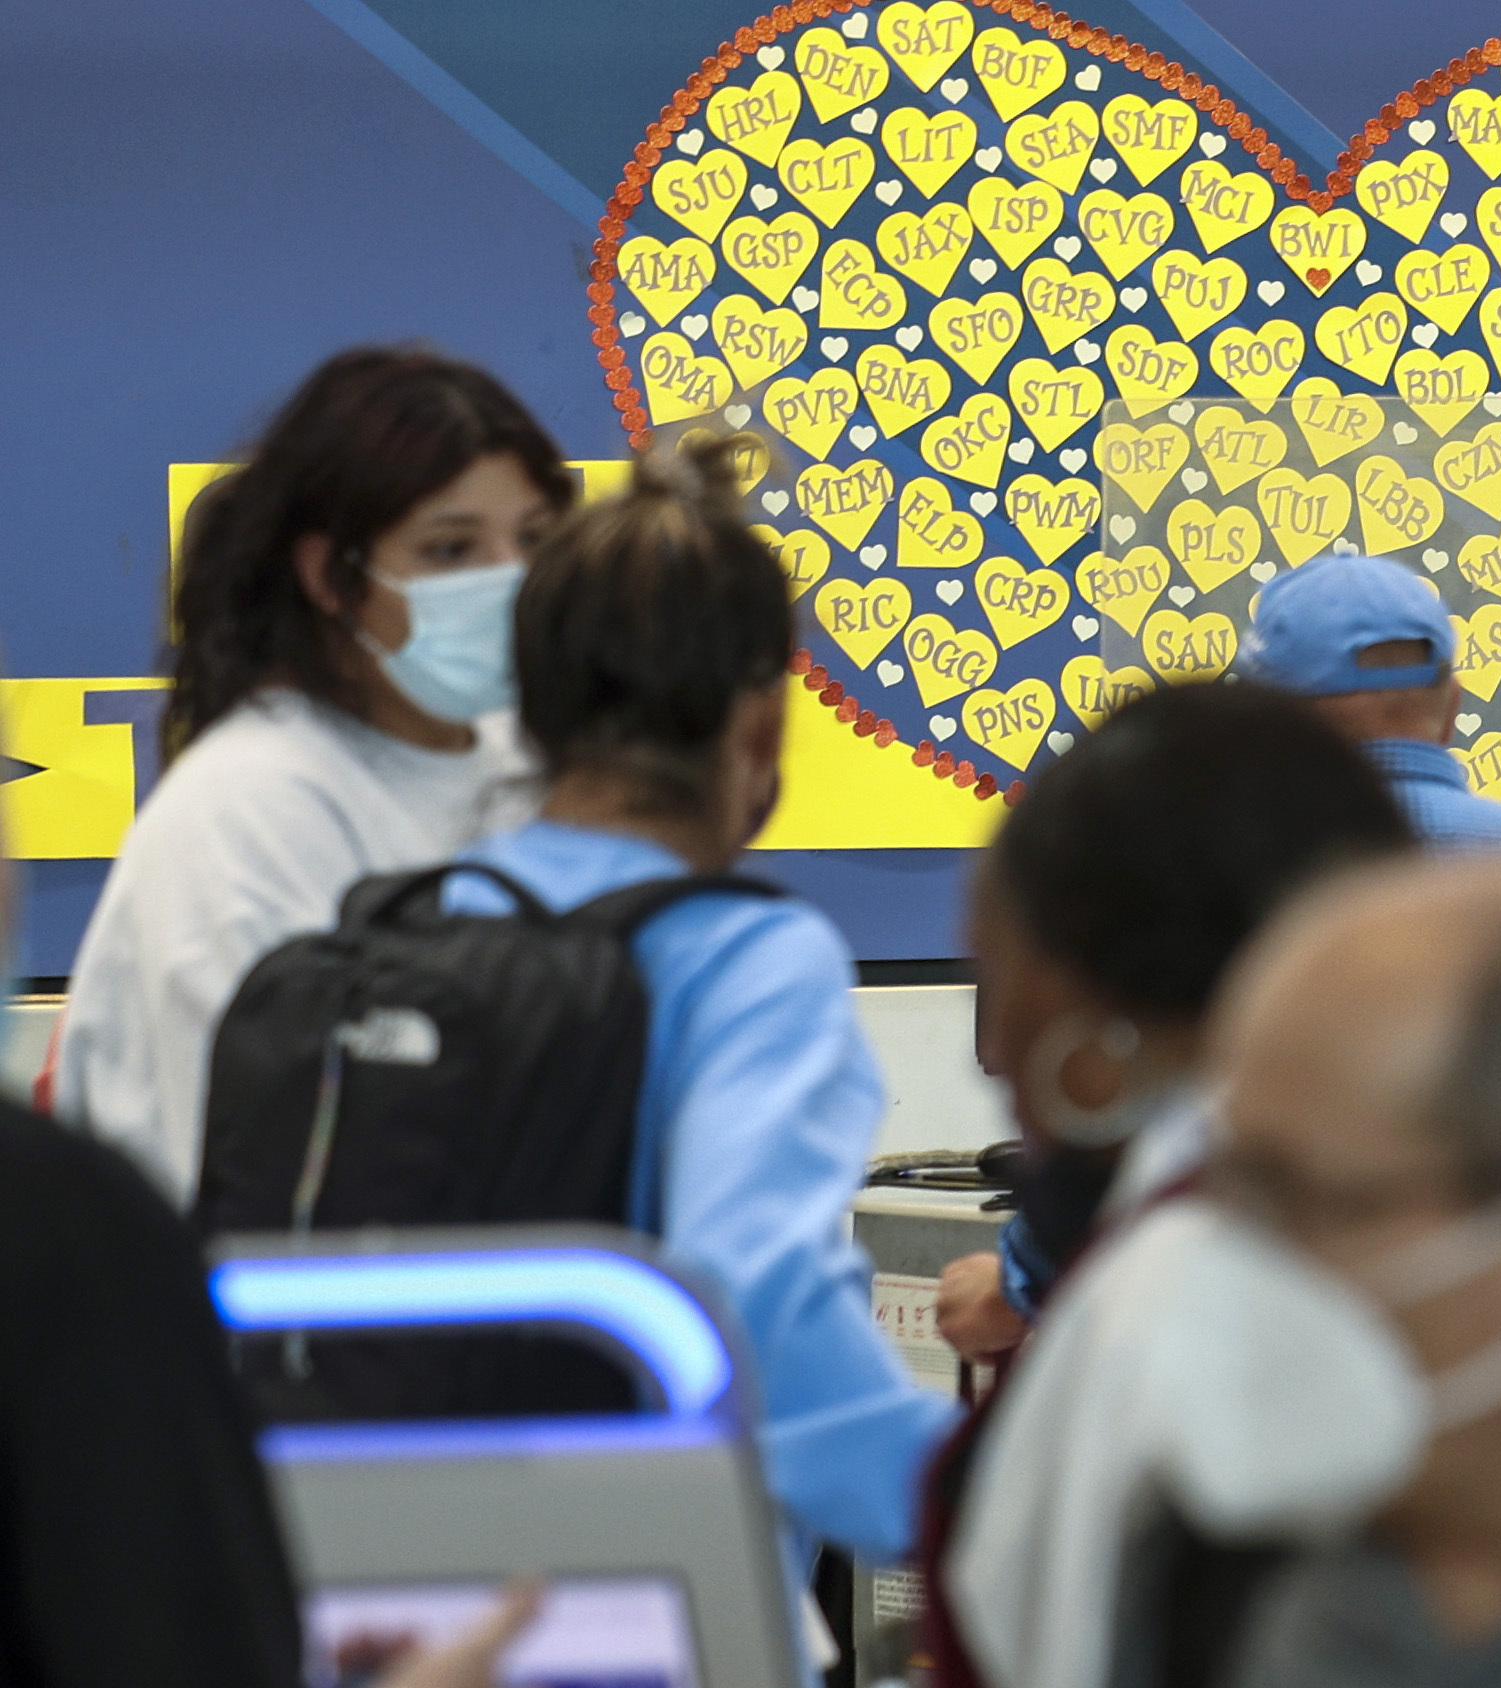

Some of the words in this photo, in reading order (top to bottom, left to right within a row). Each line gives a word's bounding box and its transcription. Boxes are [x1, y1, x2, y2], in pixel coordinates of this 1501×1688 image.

[893, 15, 964, 55] SAT
[800, 43, 880, 100] DEN
[979, 44, 1051, 88] BUF
[717, 90, 793, 143] HRL
[1112, 110, 1189, 149] SMF
[898, 123, 963, 163] LIT
[1020, 123, 1097, 167] SEA
[670, 167, 737, 214] SJU
[787, 150, 861, 191] CLT
[1366, 163, 1447, 216] PDX
[990, 197, 1048, 232] ISP
[1181, 170, 1257, 223] MCI
[733, 224, 804, 269] GSP
[892, 213, 969, 263] JAX
[1084, 210, 1166, 246] CVG
[1278, 223, 1351, 259] BWI
[621, 252, 713, 292] AMA
[826, 250, 892, 318] ECP
[1160, 264, 1232, 310] PUJ
[1406, 255, 1474, 301] CLE
[1027, 275, 1102, 326] GRR
[719, 315, 806, 367] RSW
[947, 307, 1016, 353] SFO
[1335, 312, 1400, 367] ITO
[643, 345, 716, 407] OMA
[1117, 341, 1186, 391] SDF
[1220, 337, 1301, 381] ROC
[861, 361, 933, 412] BNA
[1021, 380, 1091, 417] STL
[1406, 368, 1479, 404] BDL
[773, 388, 854, 436] PVR
[1303, 395, 1368, 441] LIR
[935, 406, 1007, 471] OKC
[1108, 436, 1176, 474] ORF
[1199, 426, 1273, 466] ATL
[799, 465, 894, 517] MEM
[1009, 488, 1096, 533] PWM
[1265, 487, 1335, 538] TUL
[1360, 469, 1430, 541] LBB
[899, 492, 967, 552] ELP
[1181, 524, 1245, 564] PLS
[983, 574, 1056, 618] CRP
[1089, 563, 1162, 606] RDU
[831, 592, 898, 631] RIC
[908, 628, 988, 687] OGG
[1155, 628, 1228, 670] SAN
[973, 693, 1046, 745] PNS
